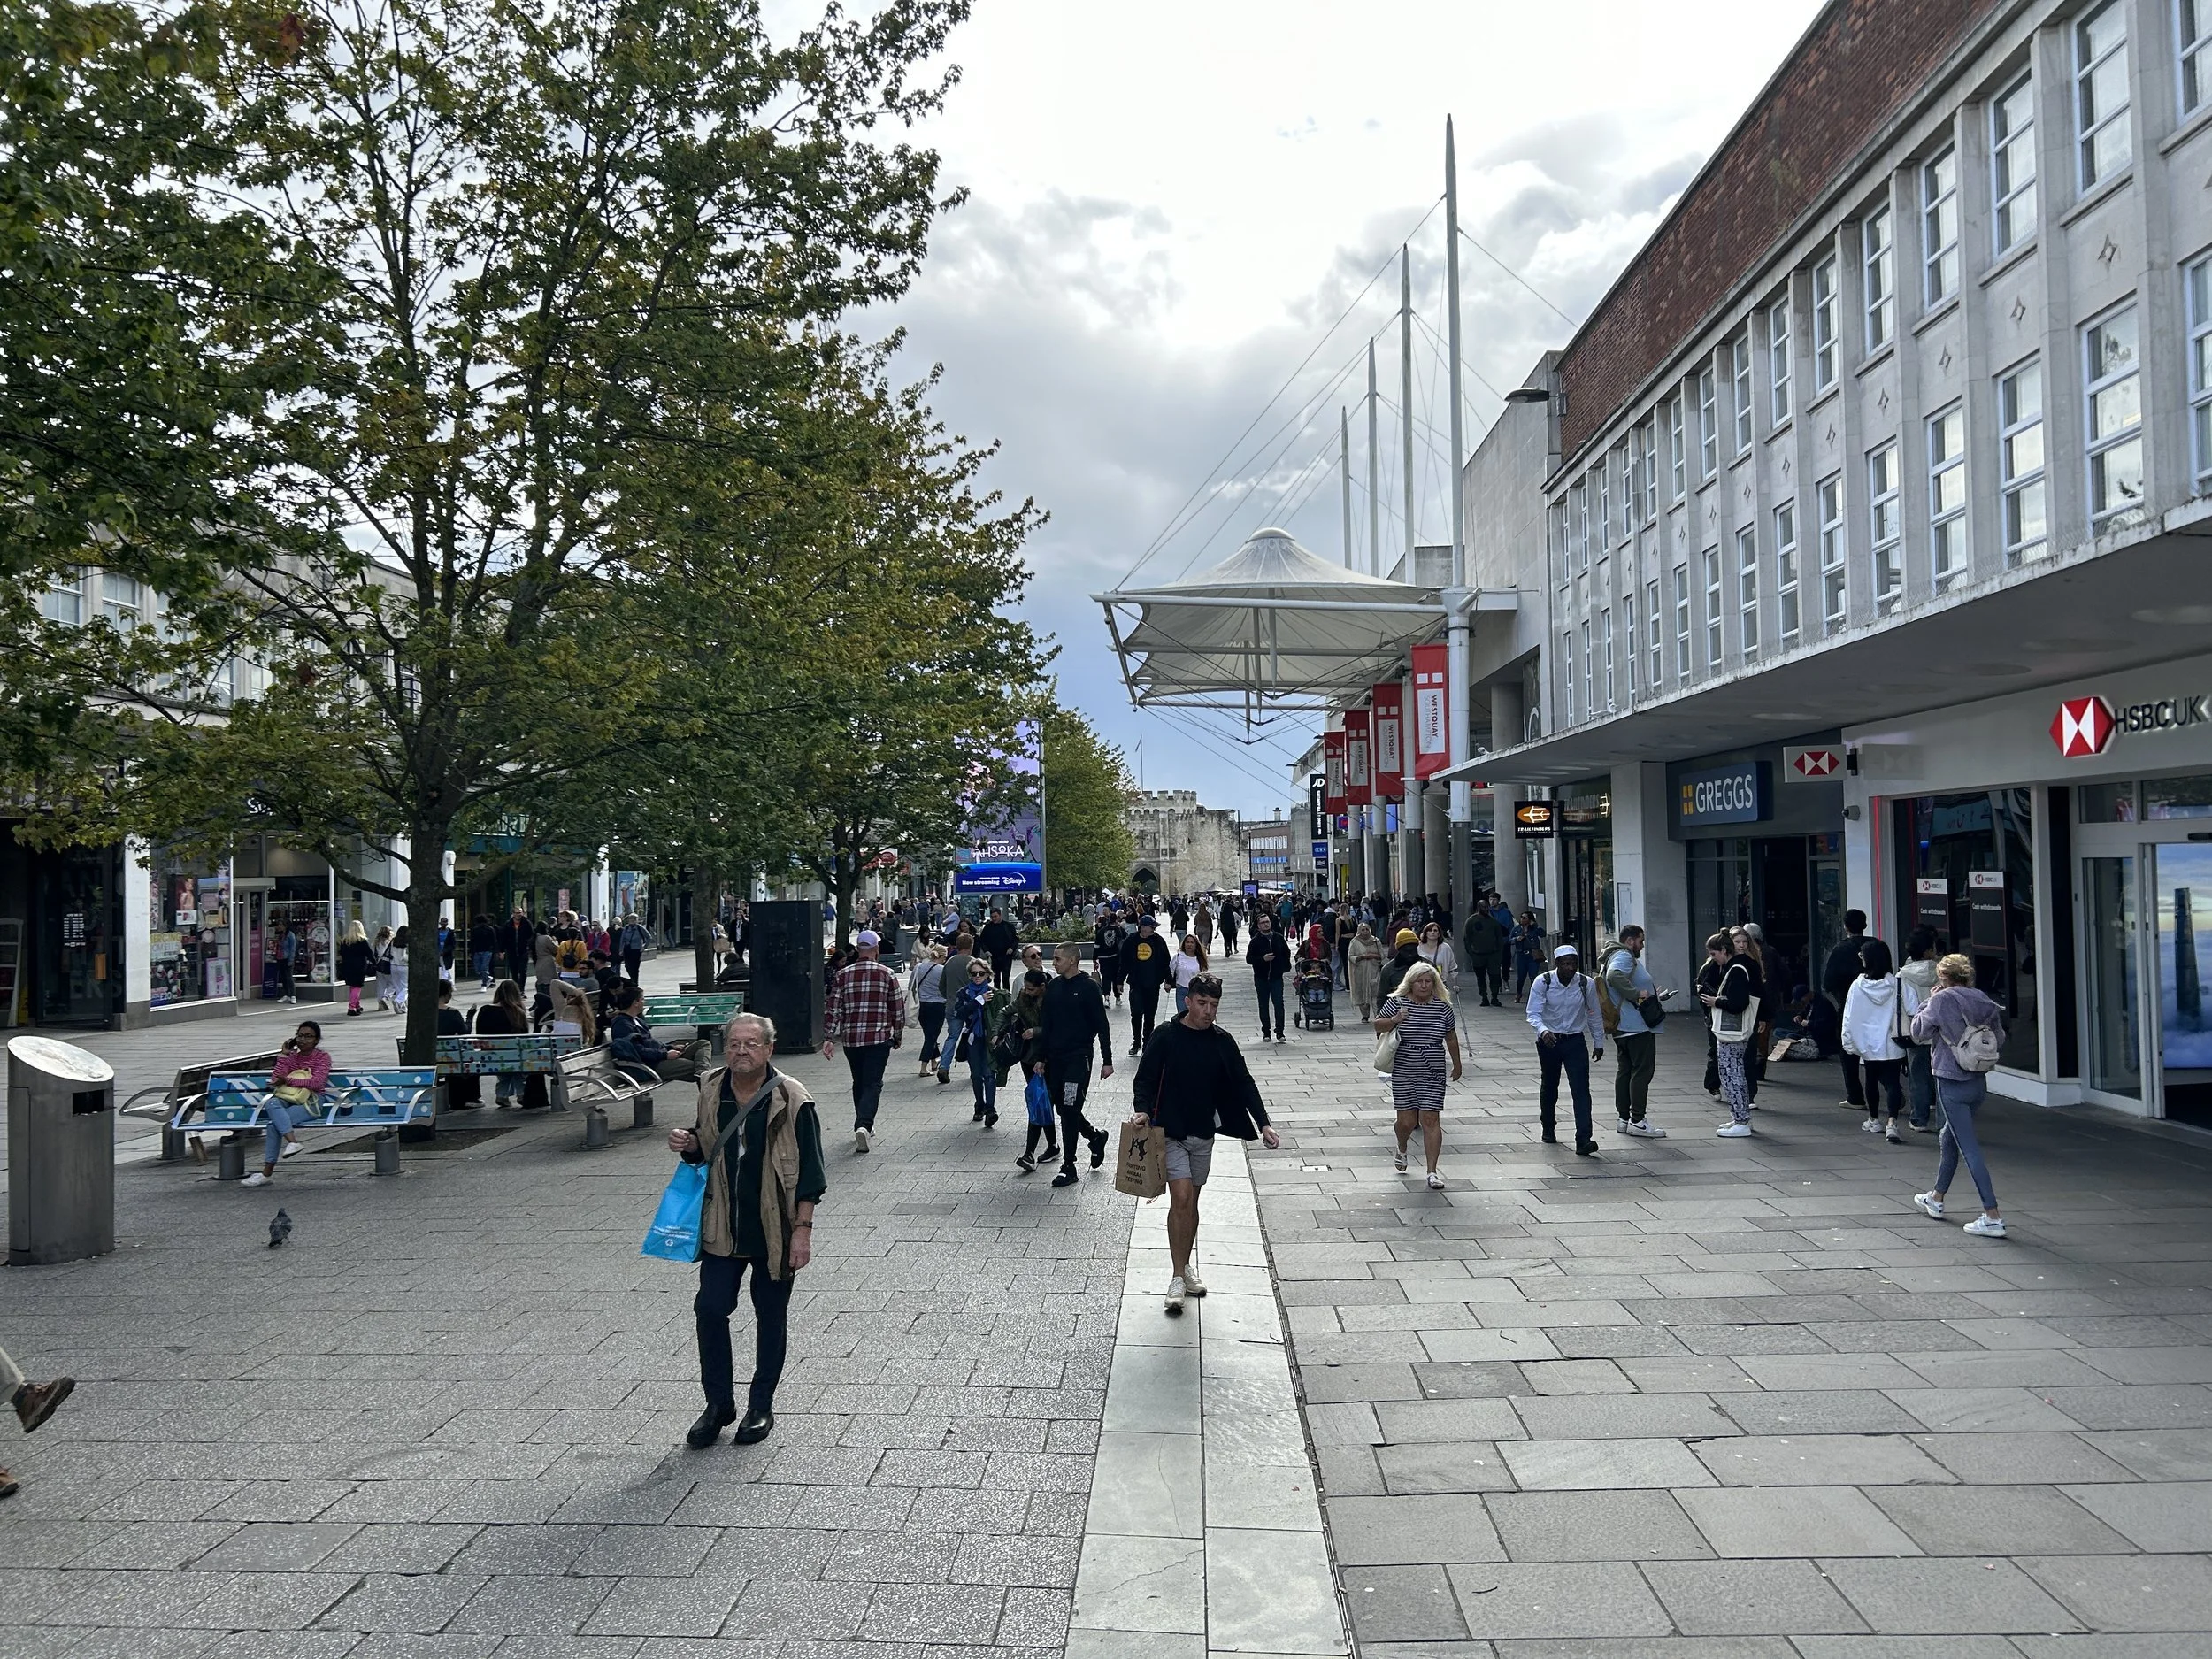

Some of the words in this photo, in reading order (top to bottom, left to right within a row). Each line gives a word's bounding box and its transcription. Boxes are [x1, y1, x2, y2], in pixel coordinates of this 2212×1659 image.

[2115, 701, 2168, 733] HSBC
[2173, 695, 2201, 726] UK
[1312, 779, 1325, 787] JD
[1695, 774, 1753, 813] GREGGS
